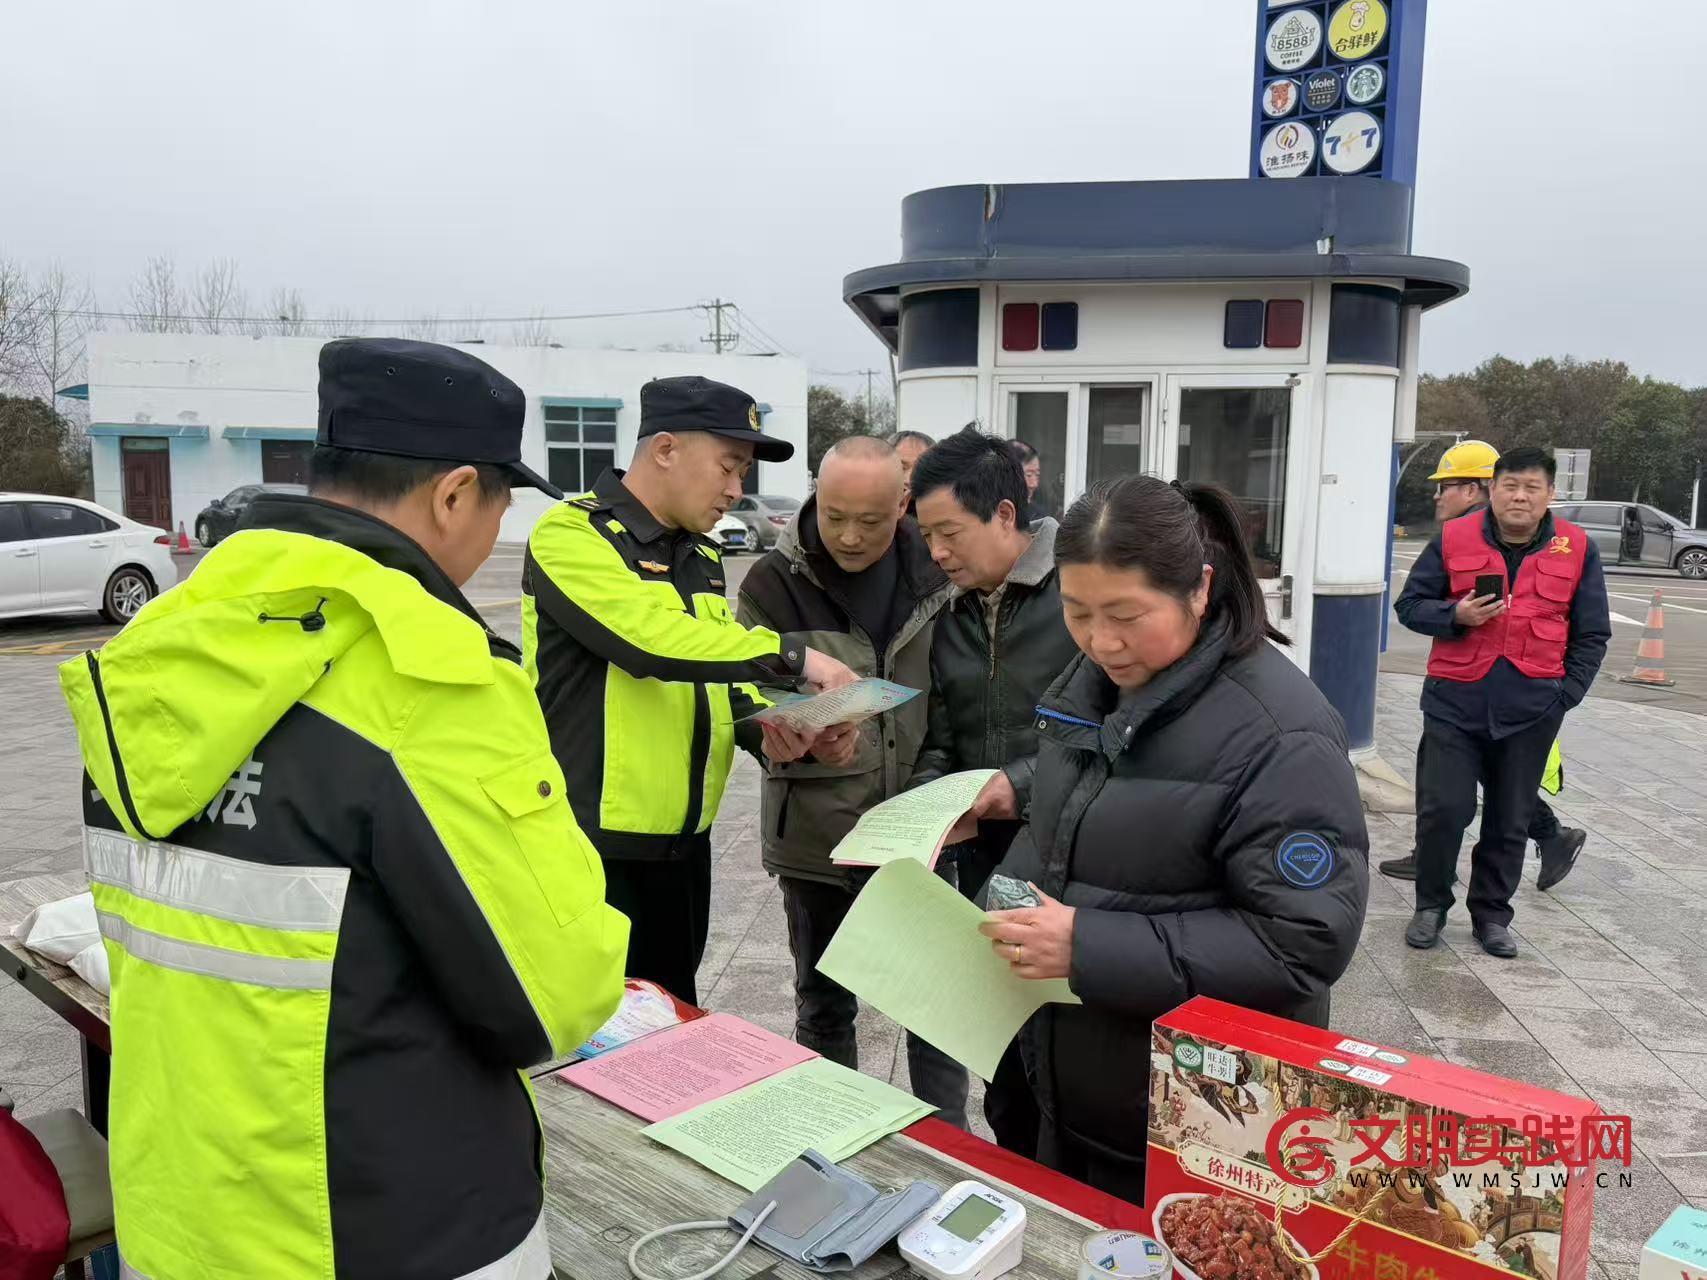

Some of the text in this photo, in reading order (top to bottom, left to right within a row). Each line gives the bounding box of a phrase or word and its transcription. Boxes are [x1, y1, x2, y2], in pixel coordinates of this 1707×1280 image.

[1277, 36, 1309, 50] 8588
[1309, 78, 1335, 89] Violet
[1208, 1156, 1282, 1194] 徐州特产
[1336, 1239, 1441, 1280] 牛肉
